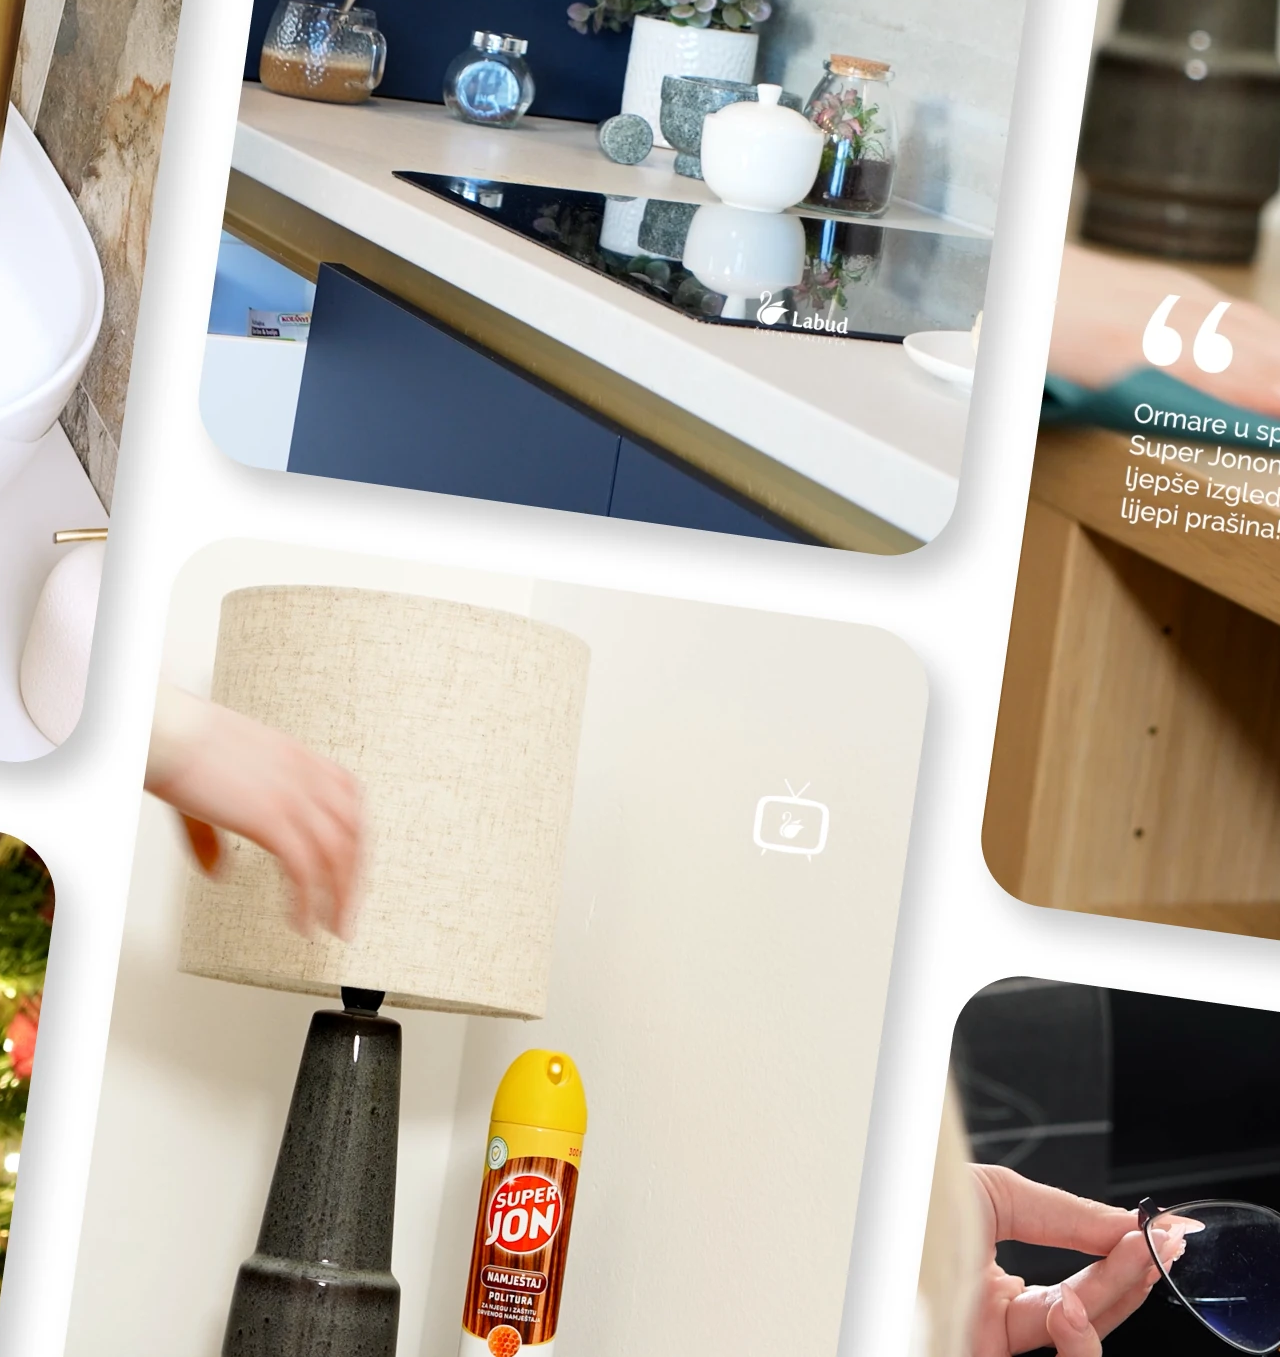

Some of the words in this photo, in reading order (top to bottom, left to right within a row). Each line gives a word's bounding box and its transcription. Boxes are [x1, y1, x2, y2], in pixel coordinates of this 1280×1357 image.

[495, 1185, 558, 1209] SUPER
[484, 1203, 556, 1246] JON
[487, 1271, 541, 1289] NAMJEŠTAJ
[488, 1291, 532, 1306] POLITURA
[489, 1304, 508, 1312] NJEGU
[512, 1306, 537, 1315] ZAŠTITU
